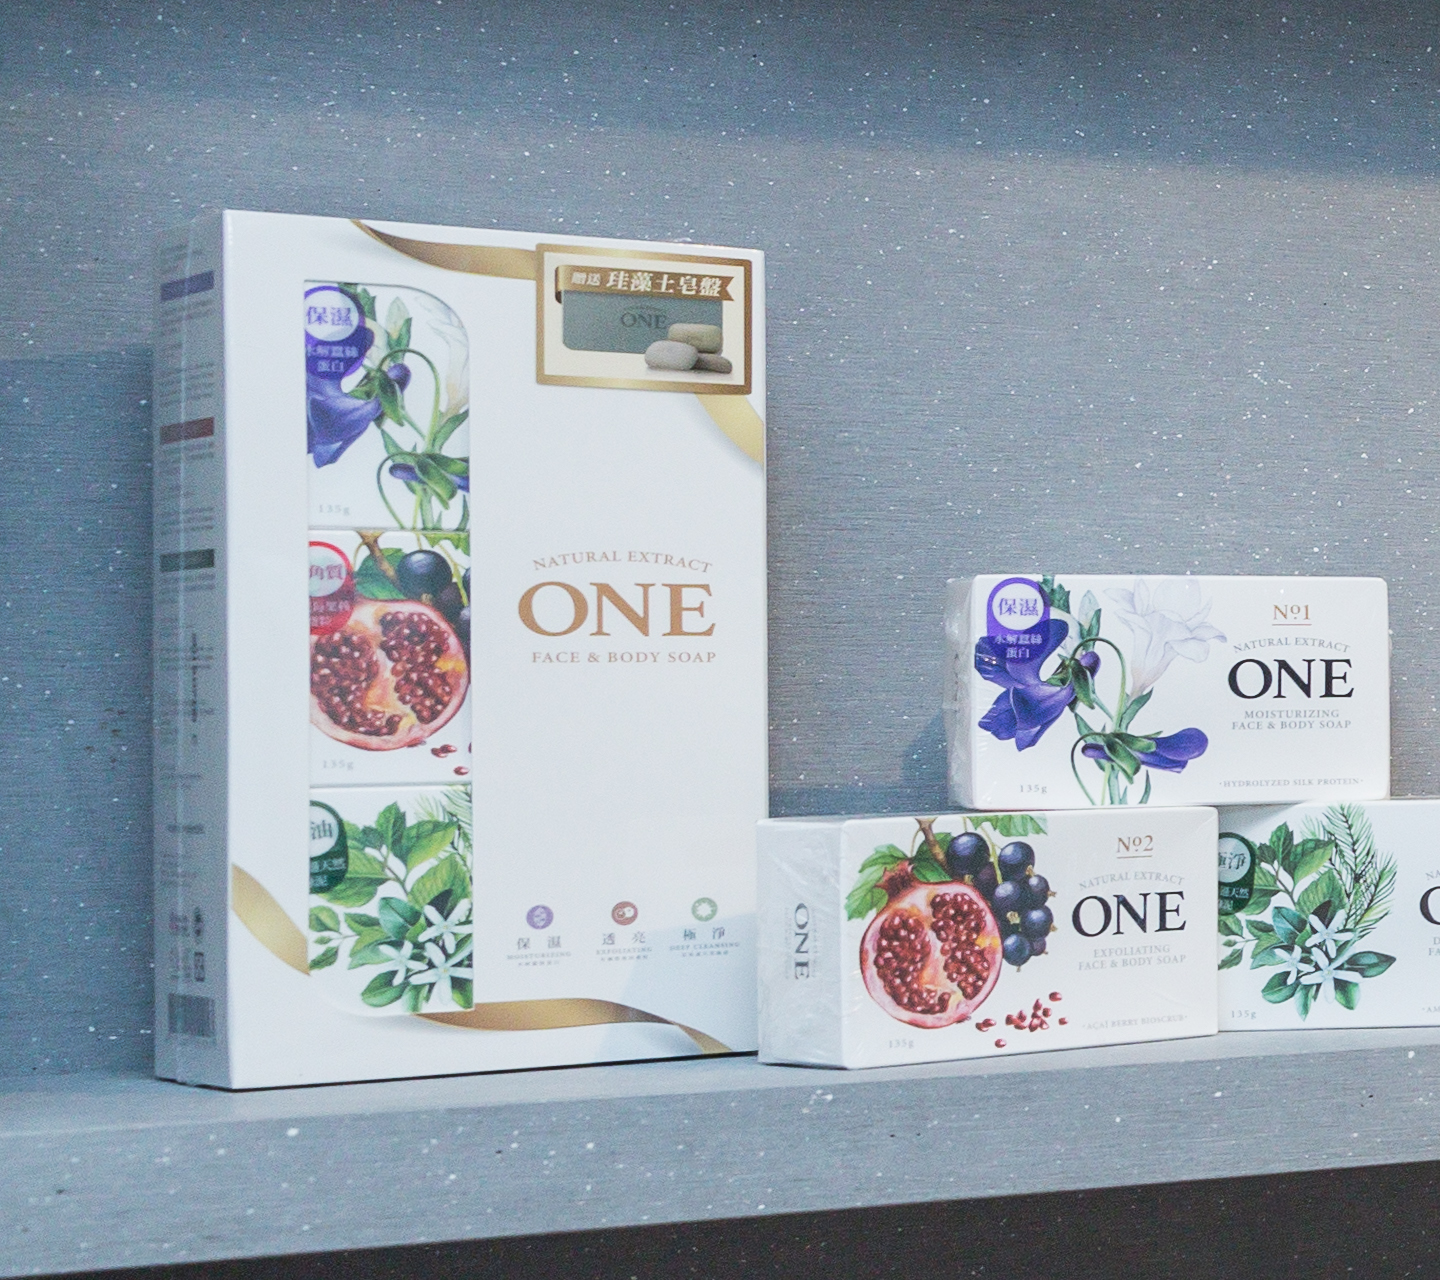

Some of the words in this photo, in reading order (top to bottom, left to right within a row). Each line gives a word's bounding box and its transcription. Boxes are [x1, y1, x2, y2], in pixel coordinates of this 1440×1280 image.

[532, 550, 621, 572] NATURAL
[627, 550, 714, 574] EXTRACT
[517, 580, 718, 638] ONE
[998, 597, 1040, 617] 保濕
[1232, 637, 1291, 654] NATURAL
[1294, 637, 1351, 654] EXTRACT
[531, 651, 583, 664] FACE
[587, 651, 601, 664] &
[606, 651, 661, 664] BODY
[667, 651, 717, 664] SOAP
[1227, 658, 1355, 699] ONE
[1244, 708, 1340, 720] MOISTURIZING
[1231, 721, 1264, 730] FACE
[1267, 721, 1278, 730] &
[1280, 720, 1316, 730] BODY
[1319, 720, 1352, 730] SOAP
[1019, 784, 1048, 795] 135g
[1071, 891, 1186, 938] ONE
[1093, 944, 1171, 959] EXFOLIATING
[888, 1038, 915, 1050] 135g
